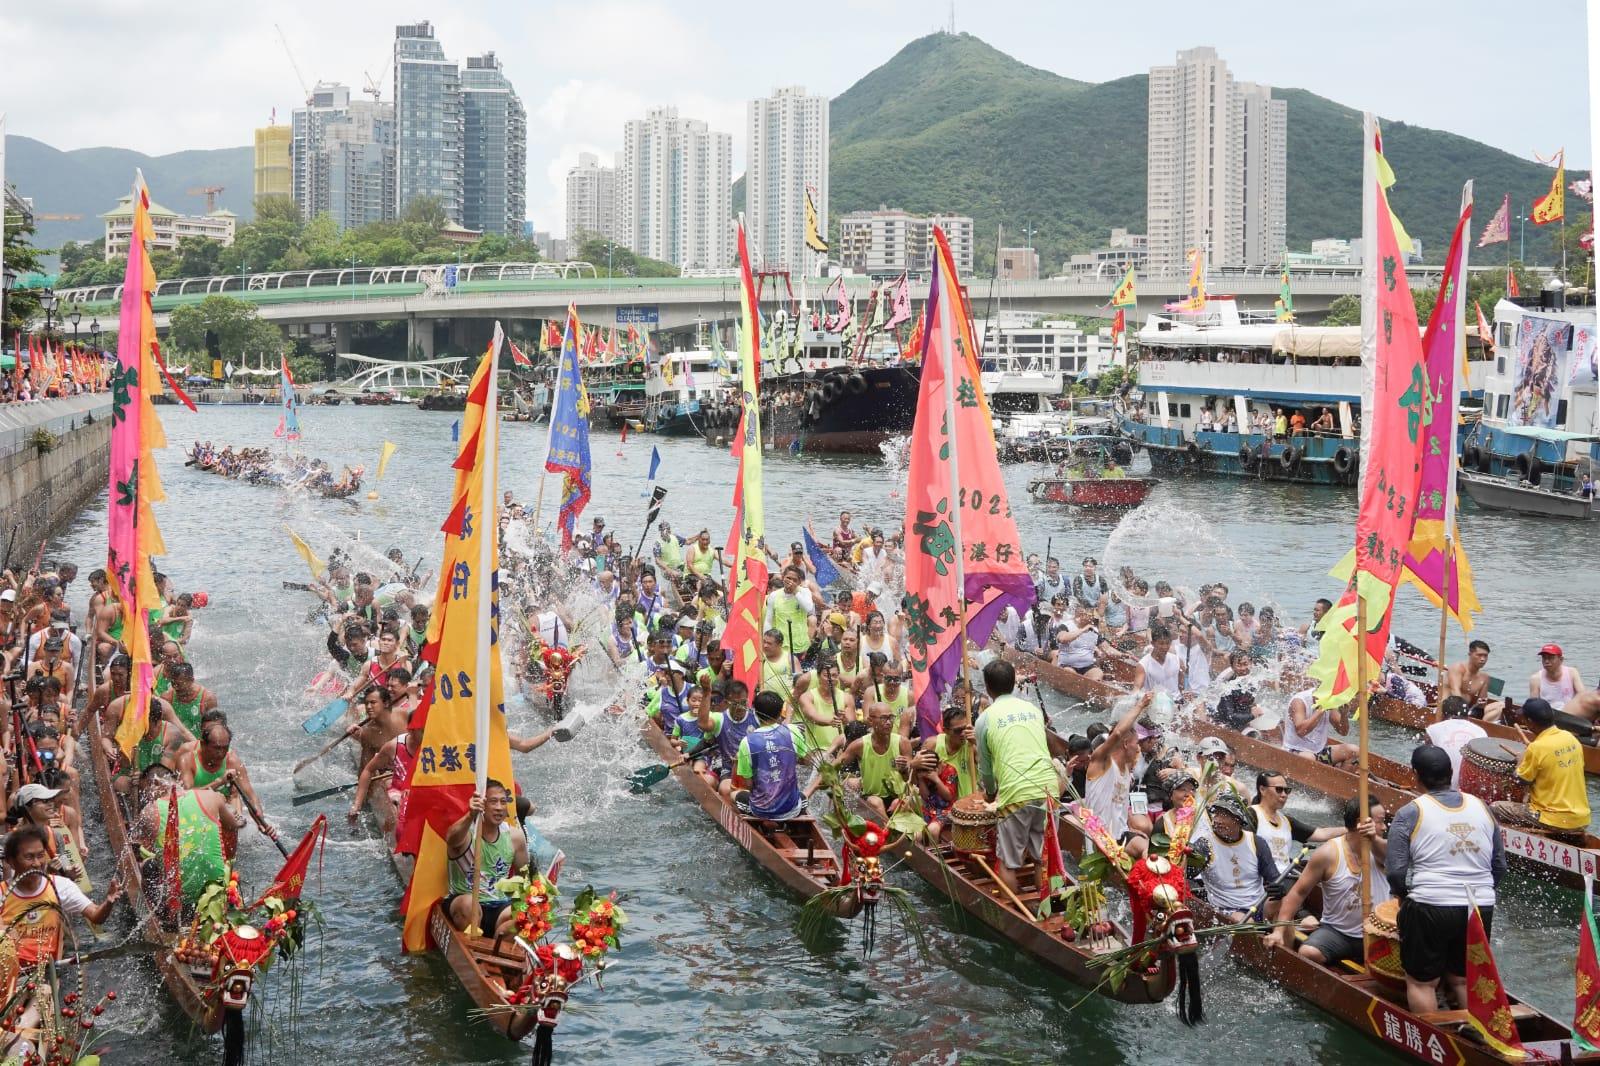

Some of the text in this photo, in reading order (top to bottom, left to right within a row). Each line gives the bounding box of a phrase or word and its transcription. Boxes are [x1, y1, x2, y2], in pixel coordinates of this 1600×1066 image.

[962, 541, 1014, 563] 港仔
[1383, 1010, 1447, 1064] 龍勝合
